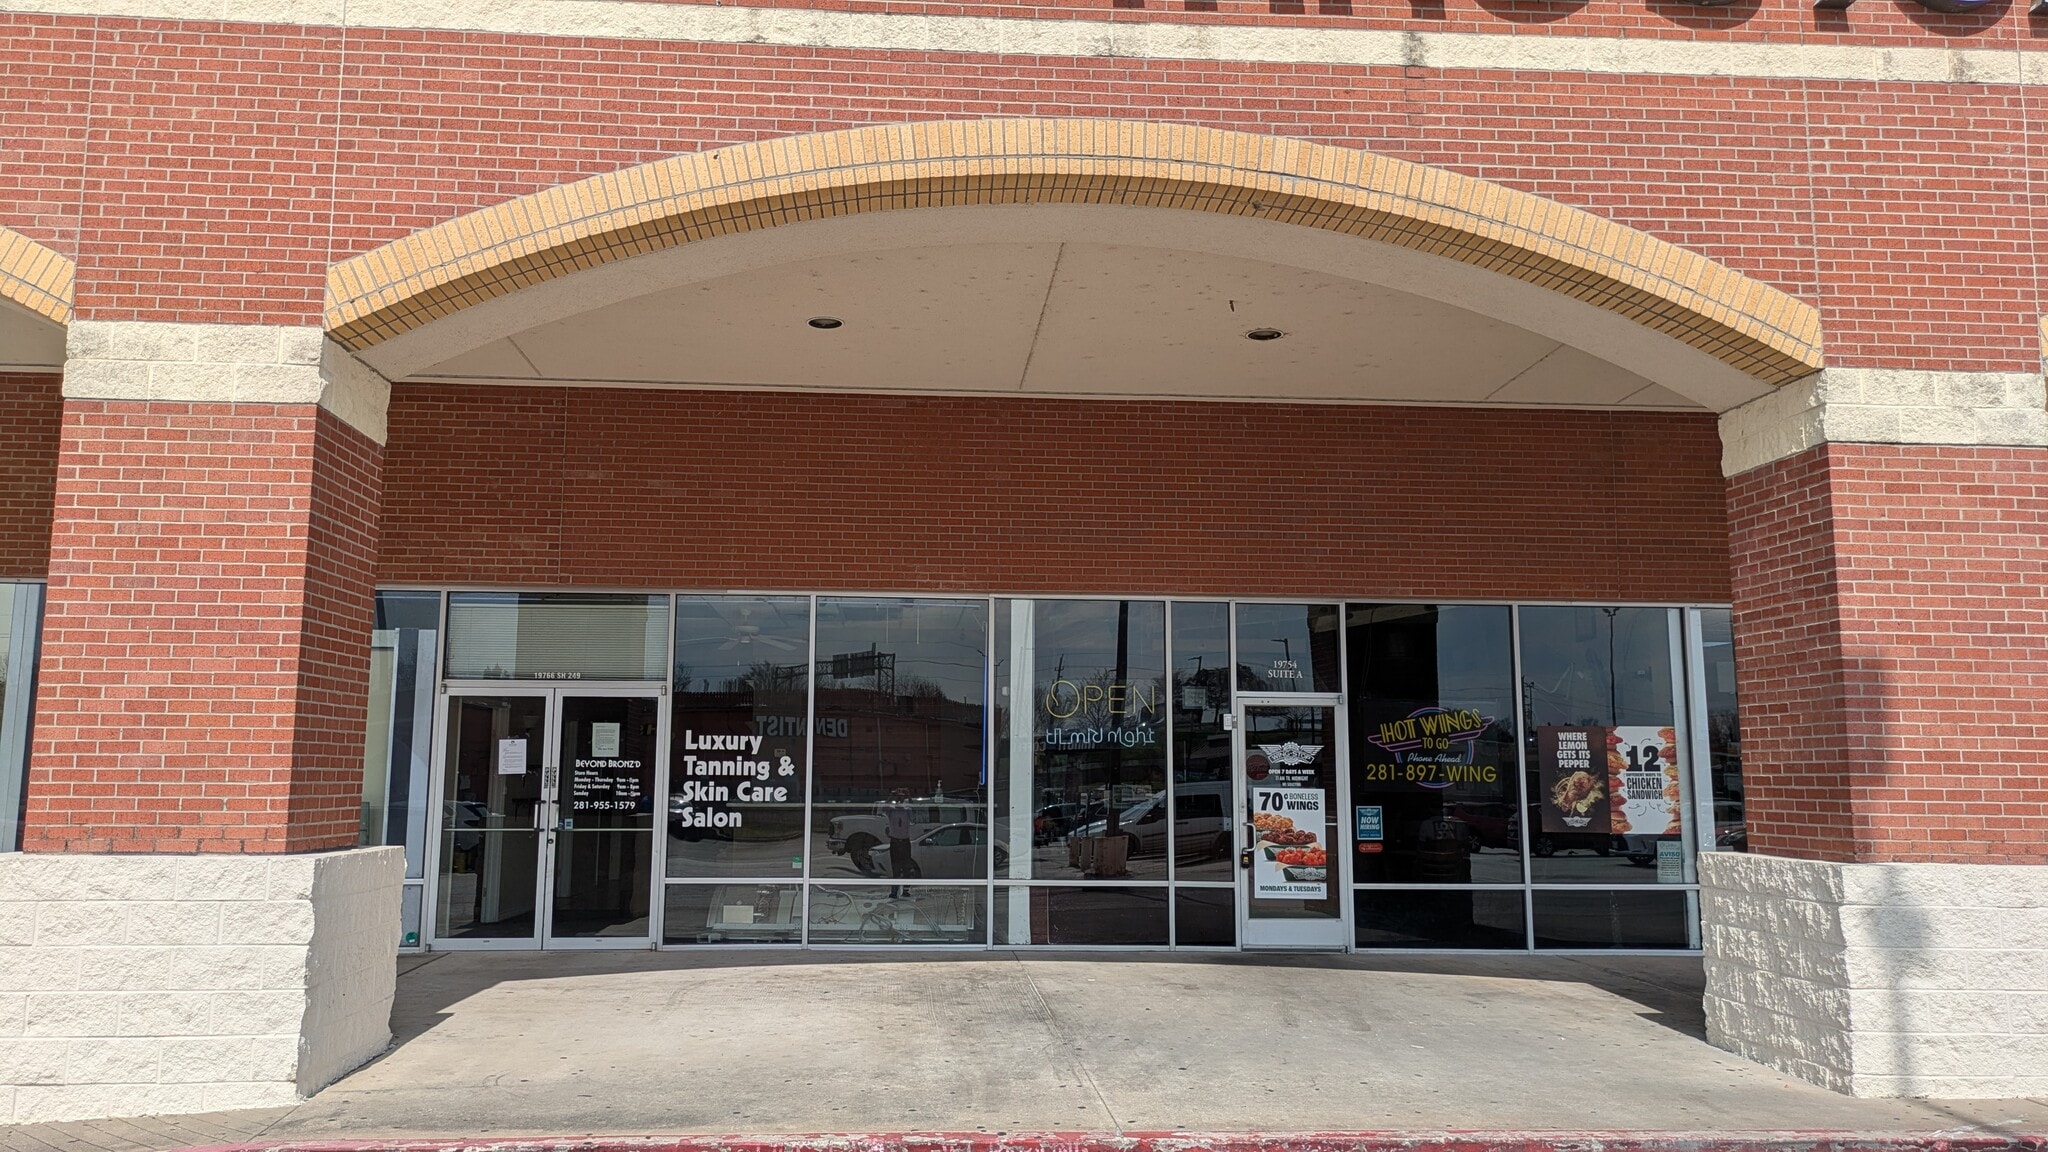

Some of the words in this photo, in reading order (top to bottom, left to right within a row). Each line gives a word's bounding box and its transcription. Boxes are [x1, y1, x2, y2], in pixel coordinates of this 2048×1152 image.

[1273, 660, 1298, 669] 19754
[1267, 669, 1294, 679] SUITE
[1296, 670, 1303, 679] A
[1045, 679, 1156, 719] OPEN
[1380, 718, 1417, 744] HOT
[1418, 708, 1483, 736] WINGS
[1557, 731, 1588, 741] WHERE
[685, 729, 763, 755] Luxury
[1422, 737, 1434, 749] TO
[1435, 737, 1449, 750] GO
[1558, 741, 1588, 750] LEMON
[1407, 752, 1433, 763] Phone
[1434, 753, 1462, 763] Ahead
[1556, 750, 1577, 759] GETS
[1578, 750, 1591, 759] ITS
[1625, 745, 1662, 772] 12
[575, 759, 607, 768] BEYOND
[683, 755, 770, 781] Tanning
[777, 755, 795, 777] &
[1558, 759, 1590, 769] PEPPER
[1366, 763, 1497, 783] 281-897-WING
[1626, 777, 1663, 790] CHICKEN
[682, 781, 729, 802] Skin
[736, 781, 788, 802] Care
[1626, 790, 1664, 800] SANDWICH
[1289, 793, 1319, 801] BONELESS
[573, 801, 636, 810] 281-955-1579
[1287, 801, 1319, 811] WINGS
[681, 806, 743, 828] Salon
[1360, 816, 1380, 824] NOW
